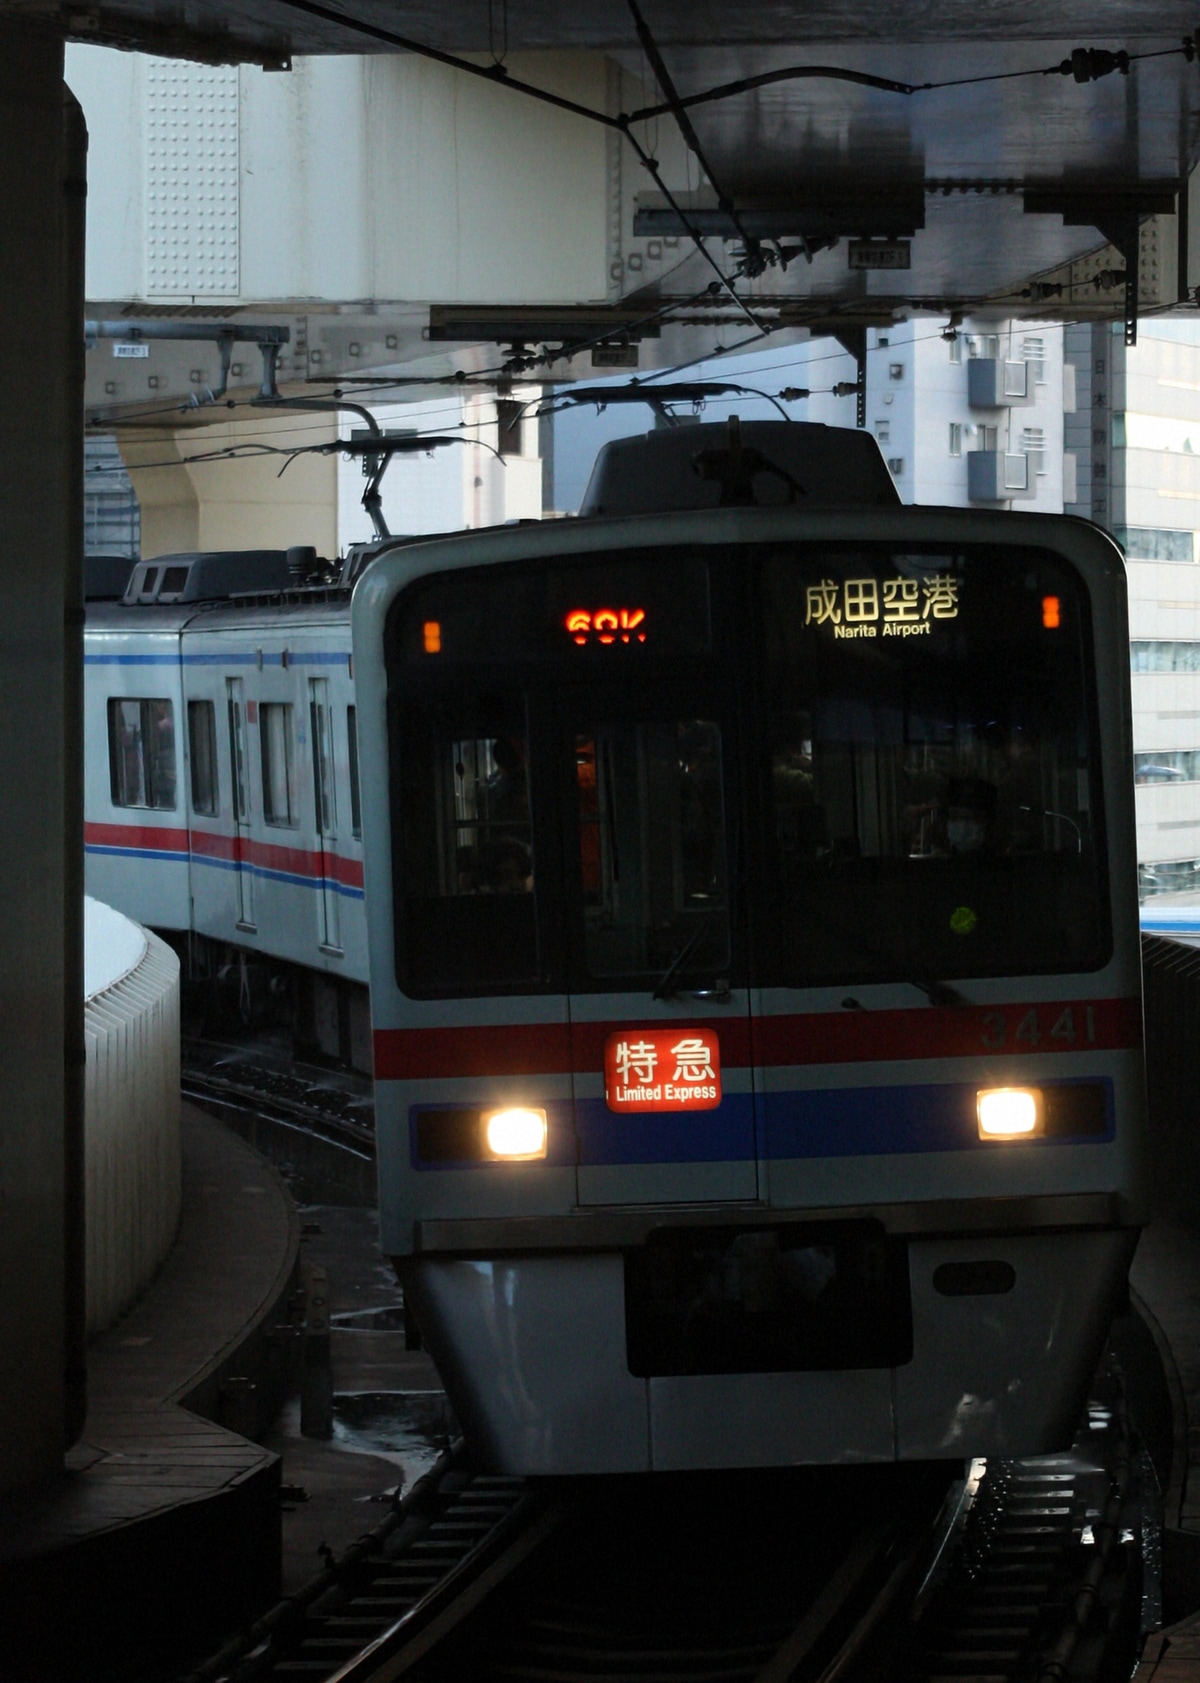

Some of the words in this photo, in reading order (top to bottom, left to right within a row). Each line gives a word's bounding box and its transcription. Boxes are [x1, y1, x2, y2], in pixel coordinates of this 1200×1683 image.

[805, 574, 958, 625] 成田空港
[833, 624, 877, 639] Narita
[882, 622, 931, 638] Airport
[981, 1006, 1096, 1049] 3441
[616, 1039, 716, 1084] 特急
[616, 1084, 661, 1102] Limited
[665, 1083, 716, 1102] Express
